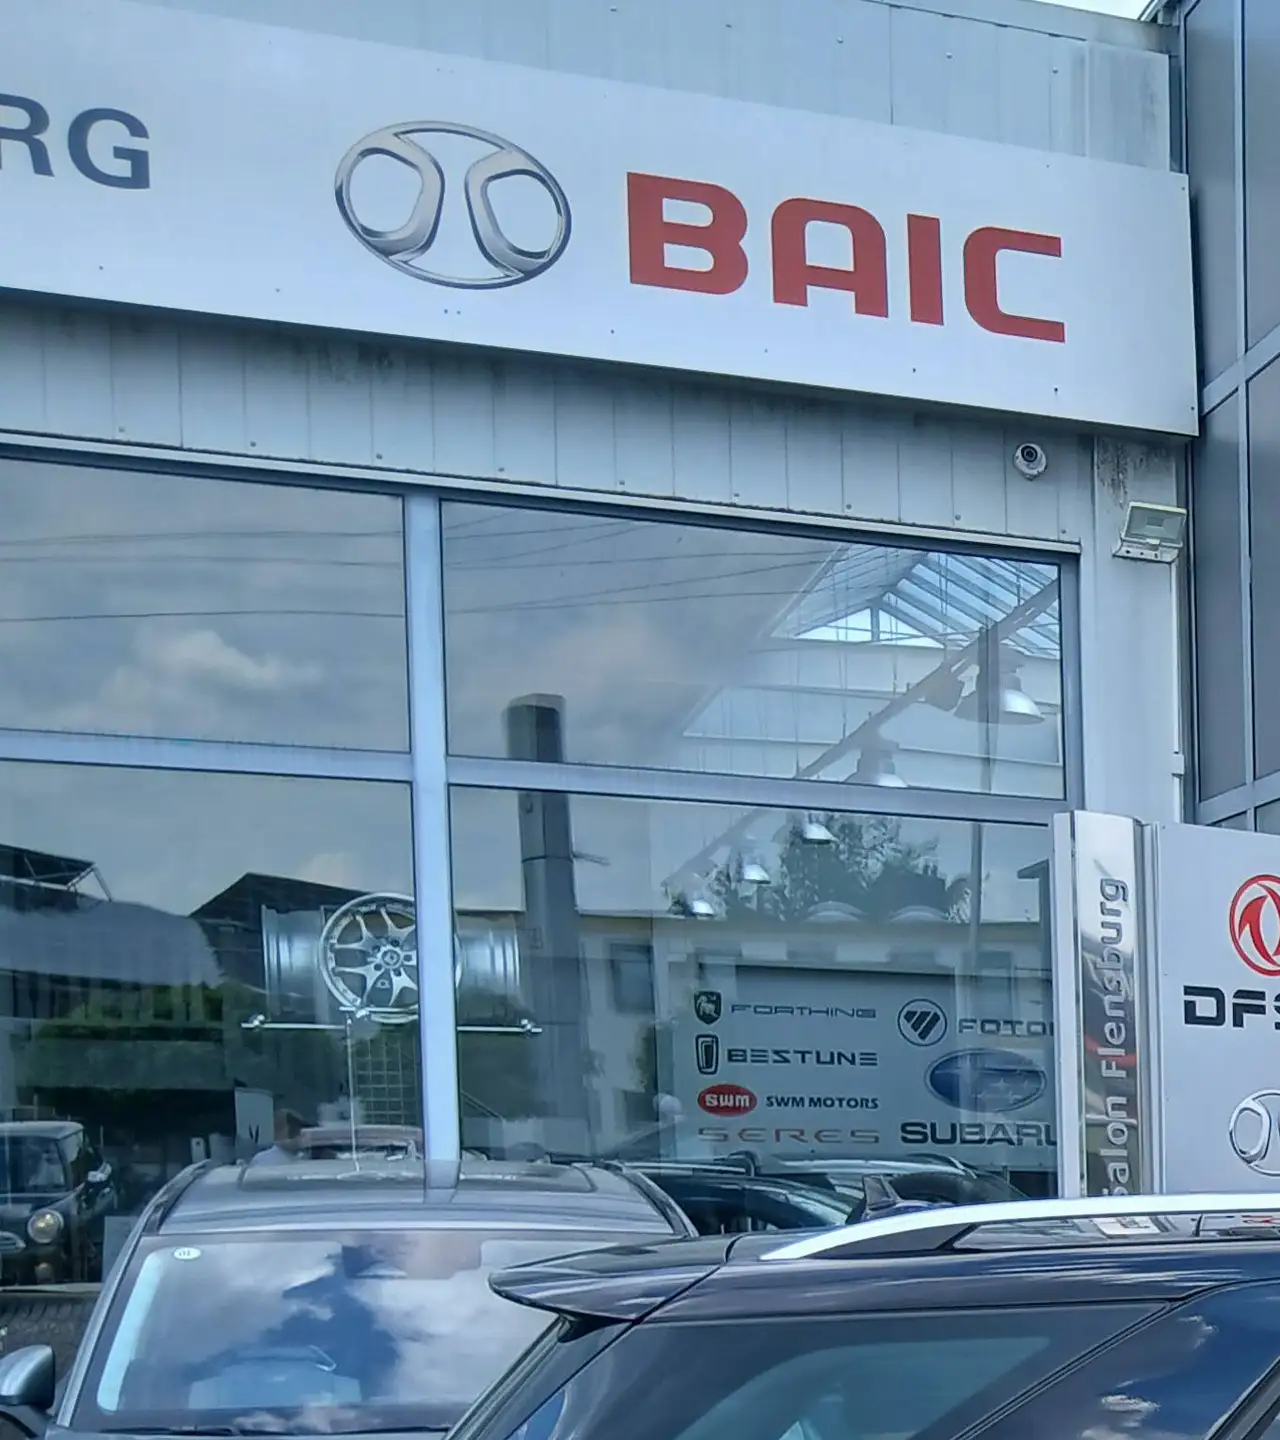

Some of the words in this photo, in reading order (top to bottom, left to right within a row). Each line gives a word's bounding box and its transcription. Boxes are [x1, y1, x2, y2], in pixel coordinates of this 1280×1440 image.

[626, 172, 1065, 342] BAIC
[1098, 877, 1129, 1078] Flensburg
[731, 1004, 877, 1018] FORTHING
[727, 1048, 878, 1066] BESTUNE
[766, 1095, 805, 1108] SWM
[808, 1096, 879, 1110] MOTORS
[698, 1127, 880, 1144] SERES
